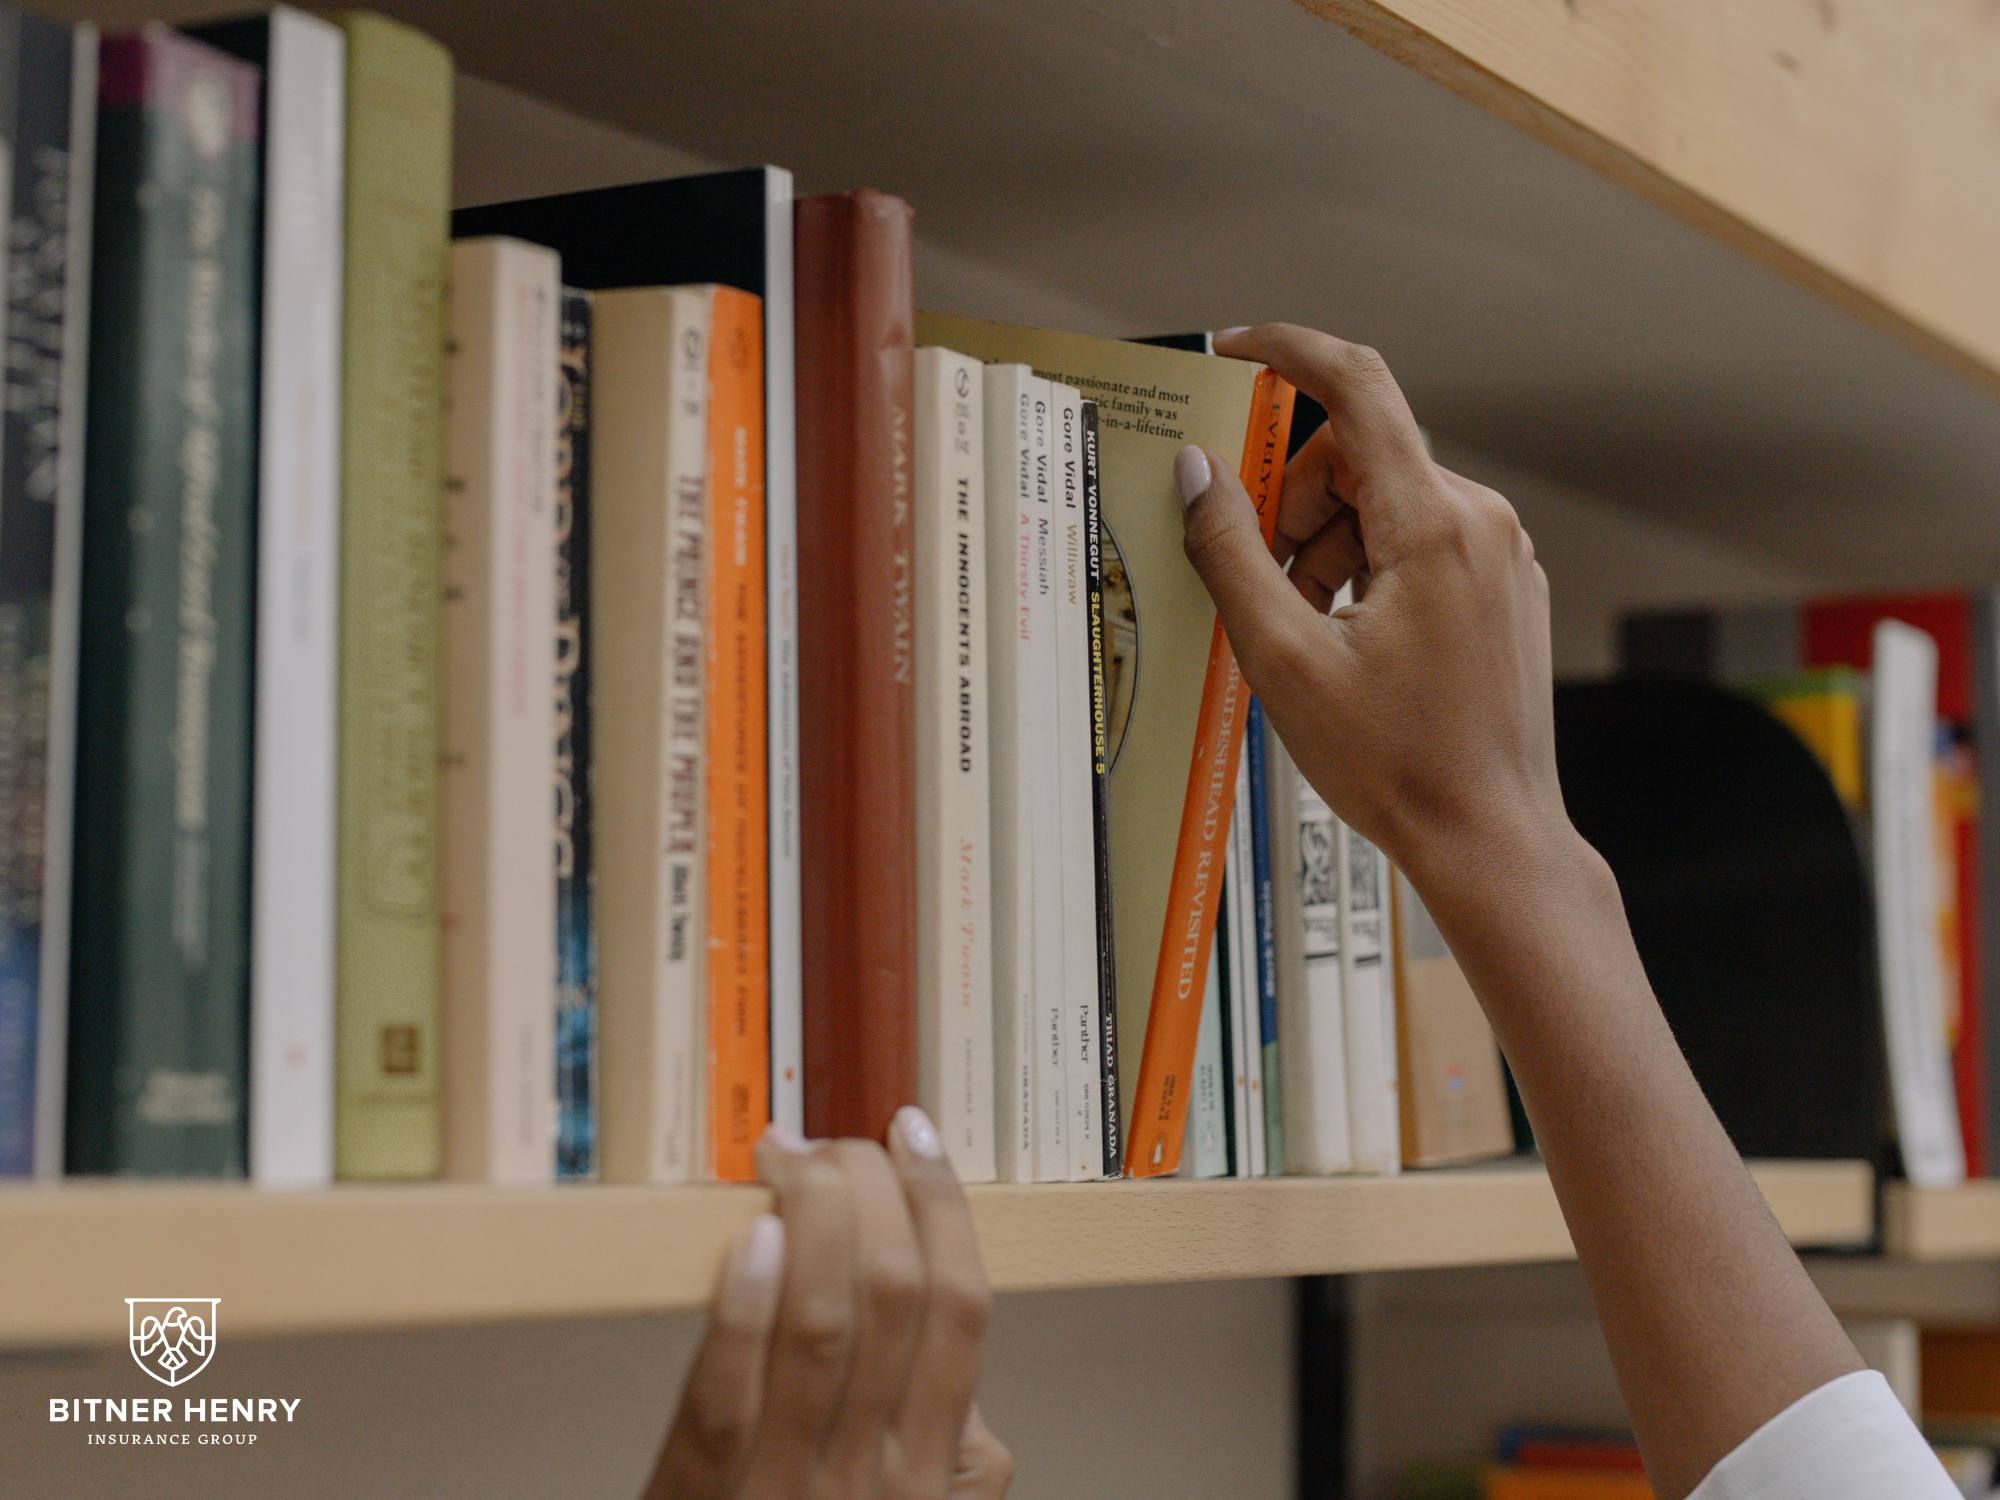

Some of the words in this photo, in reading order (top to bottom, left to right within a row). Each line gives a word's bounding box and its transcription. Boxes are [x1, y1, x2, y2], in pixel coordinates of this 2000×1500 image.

[1019, 393, 1030, 441] Gore
[1065, 375, 1130, 395] passionate
[1132, 385, 1157, 399] and
[1158, 390, 1190, 405] most
[1110, 397, 1153, 419] family
[1154, 407, 1178, 421] was
[1035, 400, 1046, 448] Gore
[1063, 407, 1074, 453] Gore
[1086, 430, 1098, 479] KURT
[892, 404, 908, 525] MARK
[1020, 449, 1030, 499] Vidal
[1037, 455, 1048, 503] Vidal
[1065, 461, 1076, 509] Vidal
[1256, 403, 1281, 517] EVELYN
[957, 477, 969, 522] THE
[1019, 512, 1030, 526] A
[1038, 518, 1049, 595] Messiah
[1088, 484, 1100, 581] VONNEGUT
[1018, 534, 1030, 600] Thirsty
[1066, 525, 1078, 605] Williwaw
[893, 549, 911, 685] TWAIN
[958, 532, 971, 668] INNOCENTS
[1090, 590, 1105, 757] SLAUGHTERHOUSE
[959, 675, 972, 773] ABROAD
[1203, 656, 1240, 842] BRIDESHEAD
[1095, 762, 1106, 775] 5
[960, 836, 974, 911] Mark
[1176, 850, 1213, 1000] REVISITED
[960, 921, 975, 1008] Twain
[1051, 1007, 1060, 1067] Panther
[1079, 1004, 1091, 1064] Panther
[1105, 1012, 1114, 1068] TRIAD
[1107, 1074, 1117, 1159] GRANADA
